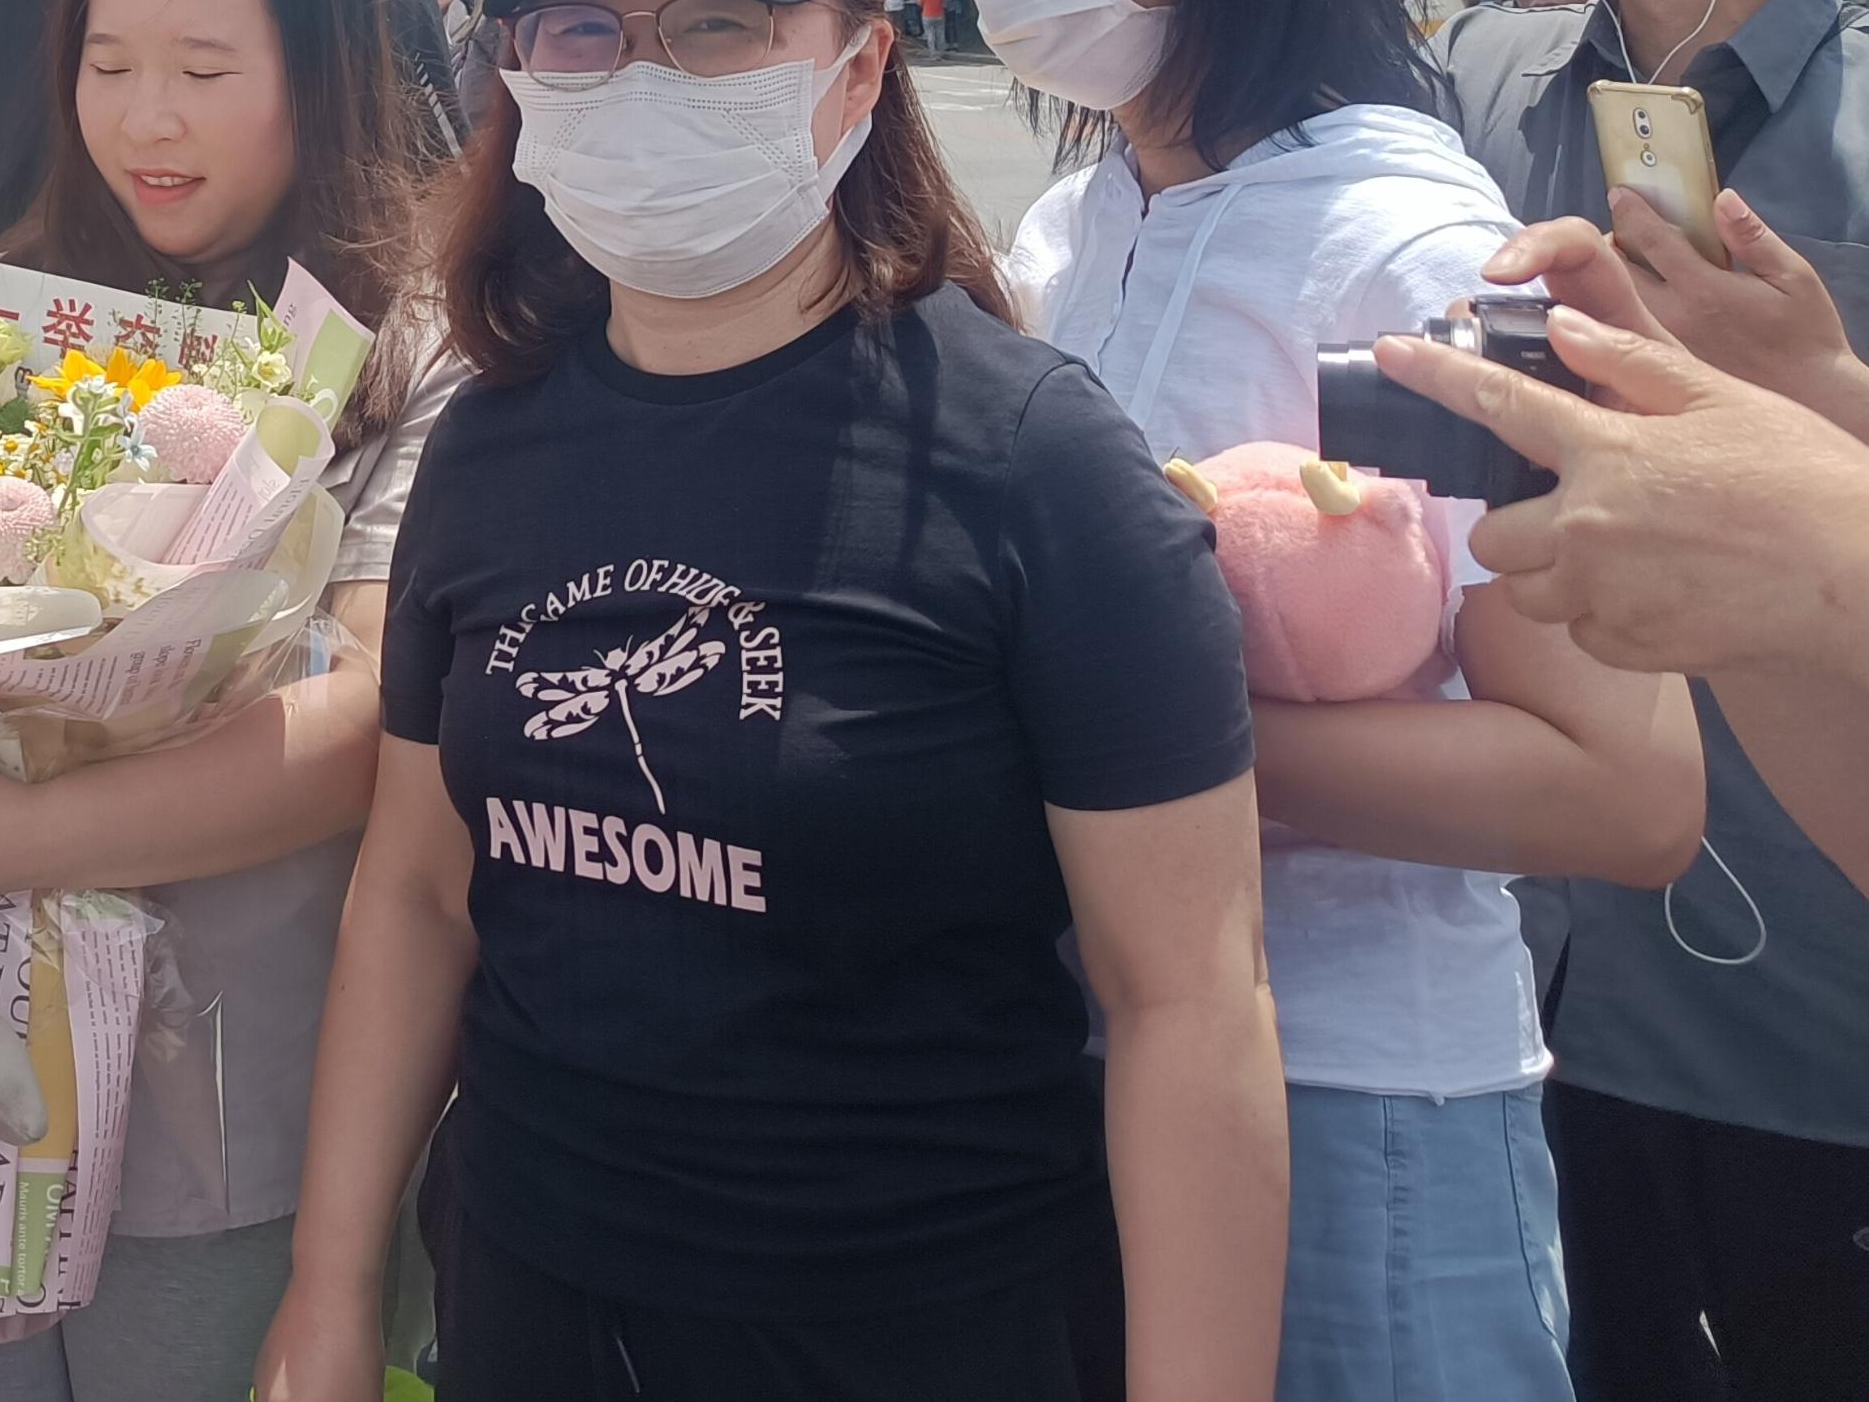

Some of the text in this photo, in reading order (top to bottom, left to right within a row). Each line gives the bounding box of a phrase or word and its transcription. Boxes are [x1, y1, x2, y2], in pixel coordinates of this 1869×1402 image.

[624, 559, 670, 592] OF
[728, 600, 766, 630] &
[739, 626, 784, 721] SEEK
[486, 797, 767, 913] AWESOME
[18, 1181, 30, 1220] Mauris
[18, 1223, 27, 1251] ante
[17, 1253, 27, 1285] tortor
